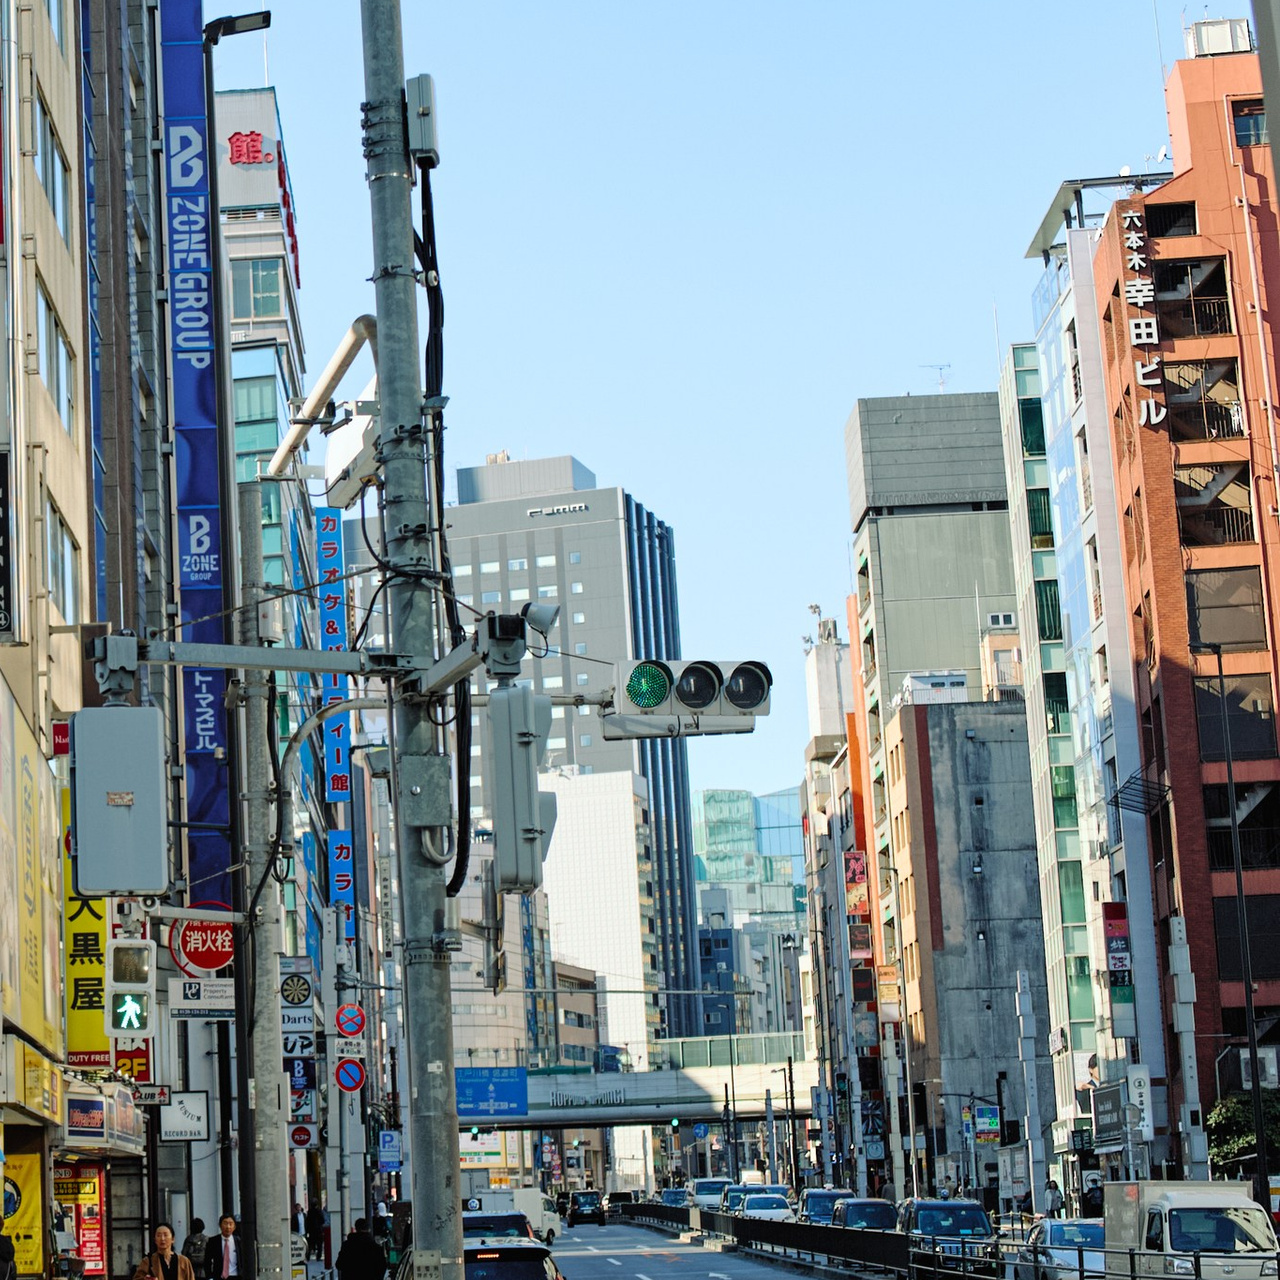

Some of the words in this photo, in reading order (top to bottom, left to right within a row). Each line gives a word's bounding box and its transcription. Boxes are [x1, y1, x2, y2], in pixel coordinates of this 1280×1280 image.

[1122, 209, 1168, 428] 六本木幸田ビル
[182, 555, 219, 573] ZONE
[189, 572, 213, 581] GROUP
[193, 671, 218, 751] トーマスビル
[334, 843, 355, 947] カラオ
[186, 930, 233, 952] 消火栓
[282, 1014, 313, 1025] Darts
[69, 1054, 89, 1063] DUTY
[91, 1053, 110, 1062] FREE
[117, 1058, 147, 1077] 2F
[133, 1089, 156, 1100] CLUB
